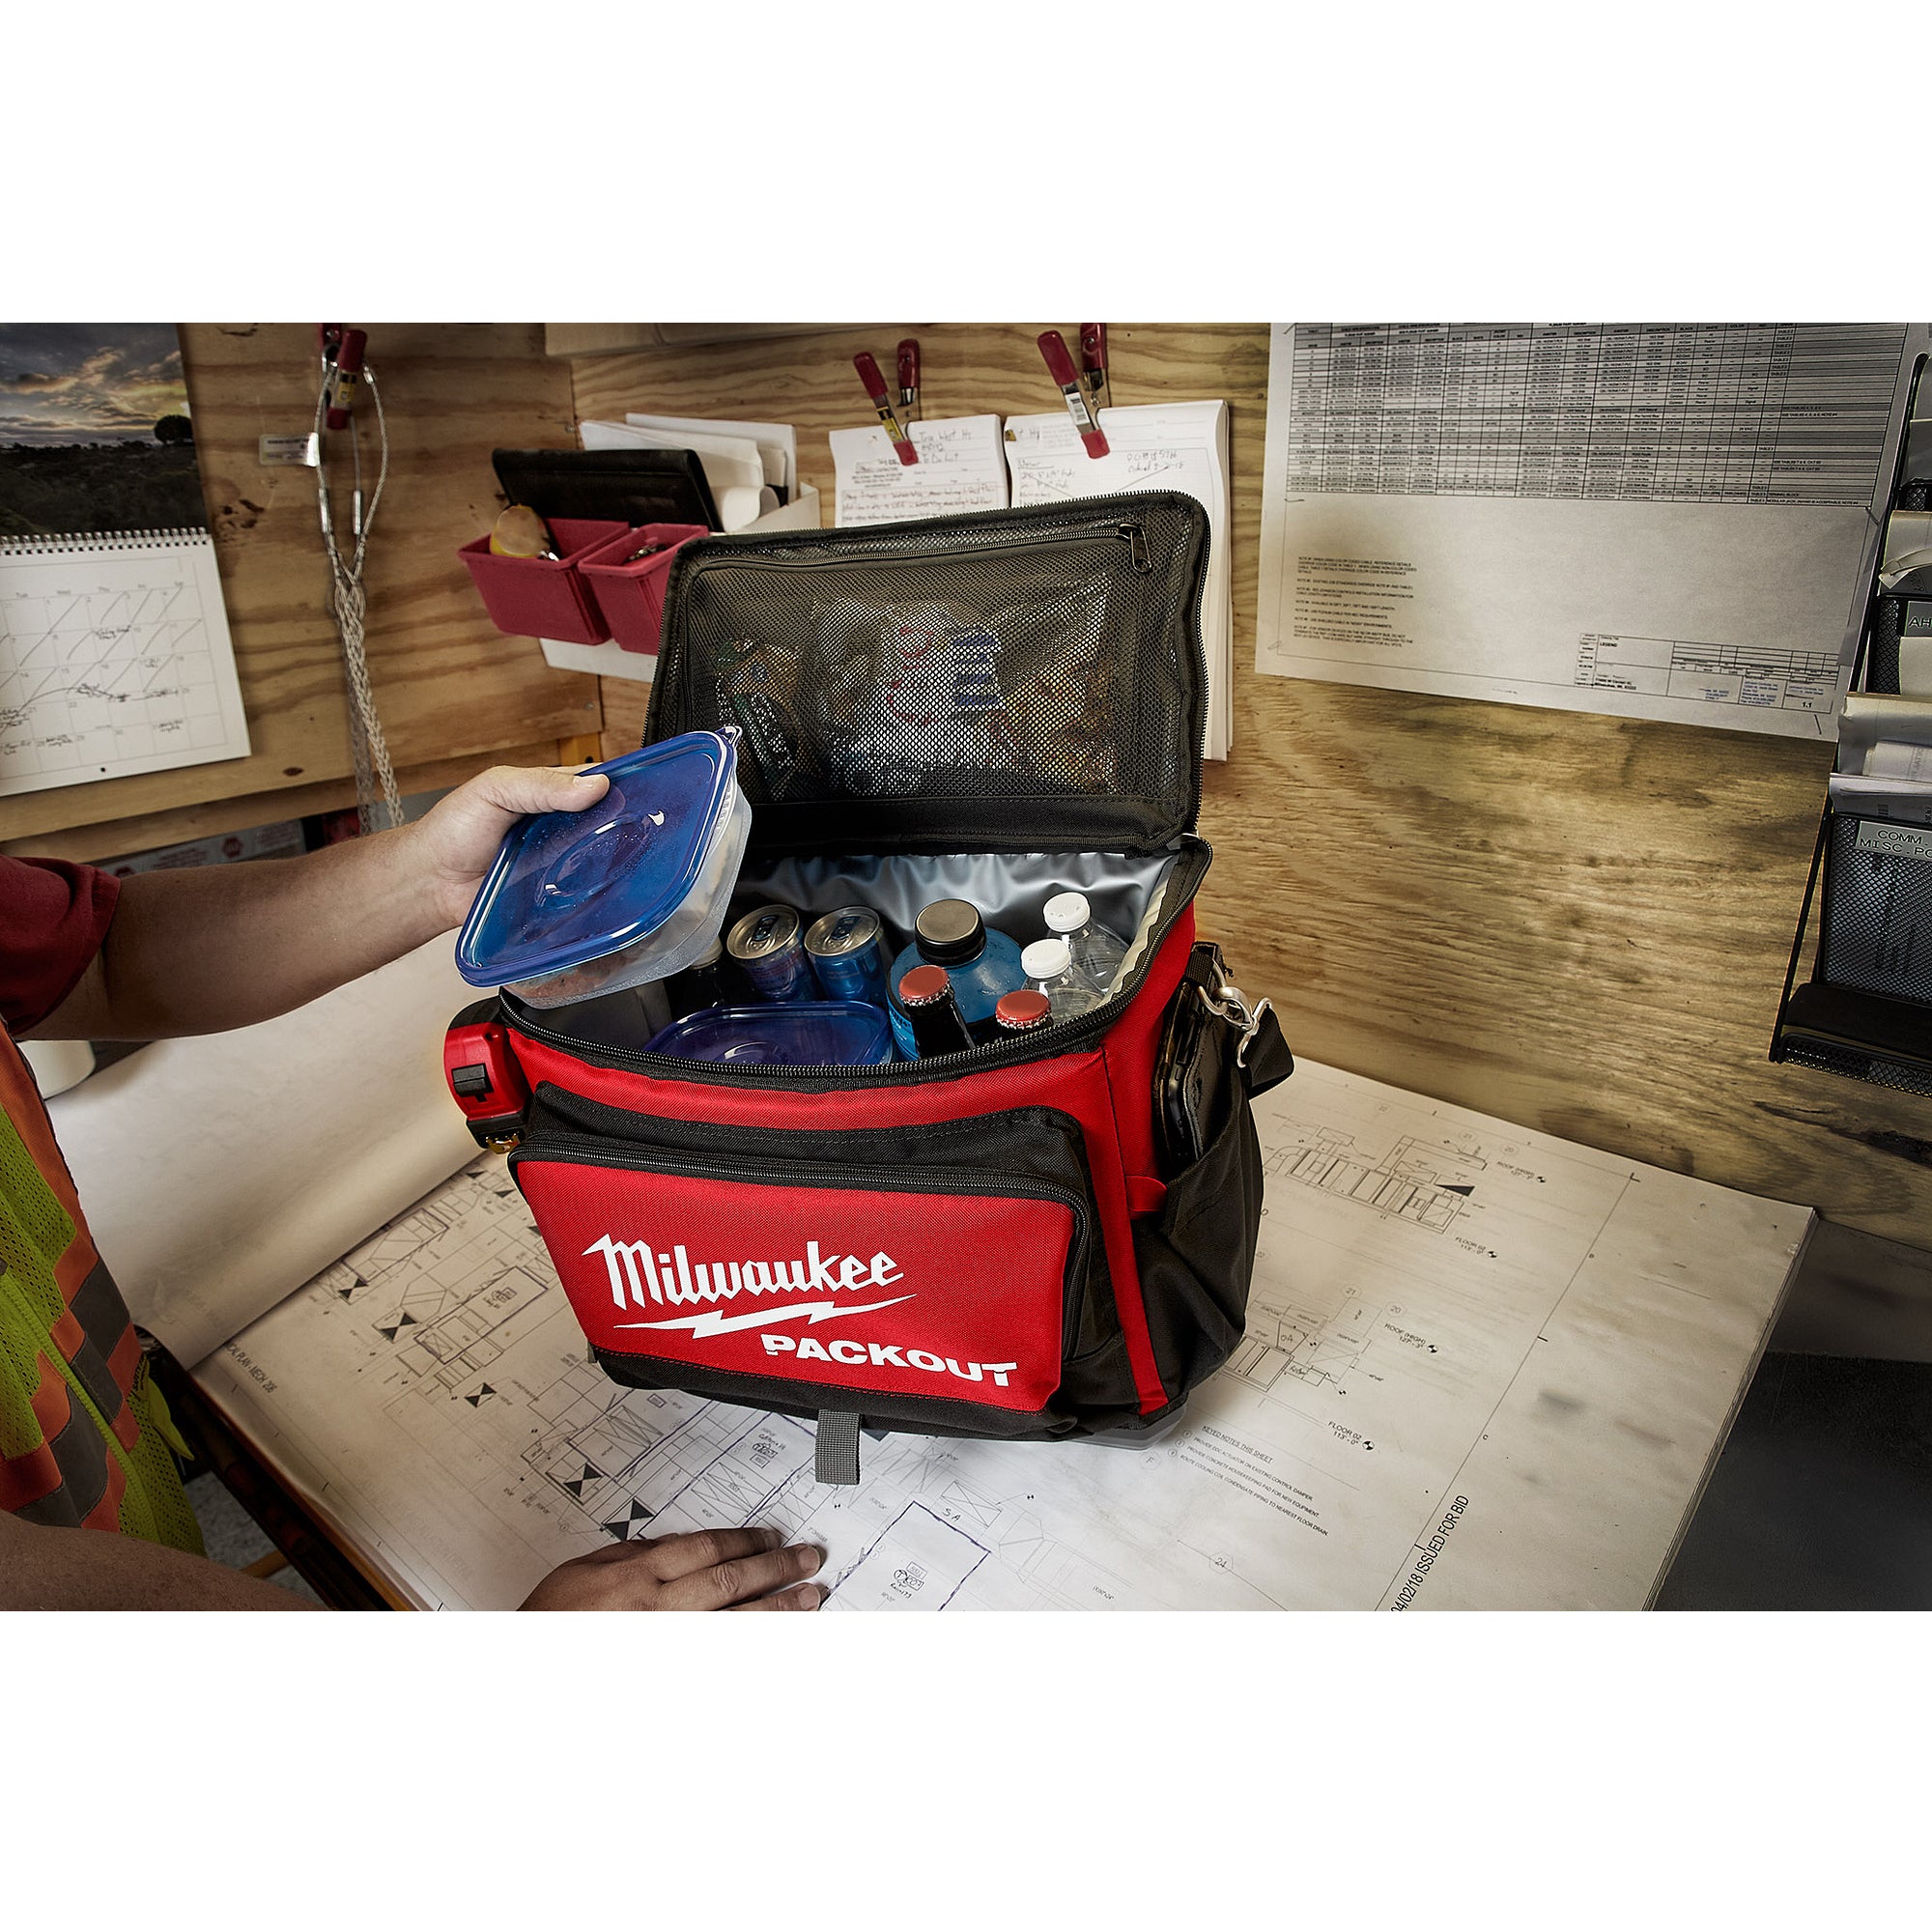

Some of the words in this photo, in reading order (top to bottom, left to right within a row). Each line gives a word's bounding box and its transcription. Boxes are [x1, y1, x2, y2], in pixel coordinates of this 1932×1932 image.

[582, 1233, 904, 1310] Milwaukee
[760, 1334, 1018, 1387] PACKOUT
[1327, 1420, 1352, 1436] FLOOR
[1221, 1434, 1240, 1446] NOTES
[1254, 1451, 1273, 1463] SHEET
[1272, 1477, 1293, 1489] CONTROL
[1276, 1505, 1298, 1518] NEAREST
[1414, 1534, 1445, 1575] ISSUED
[1437, 1513, 1460, 1537] FOR
[1450, 1495, 1469, 1515] BID
